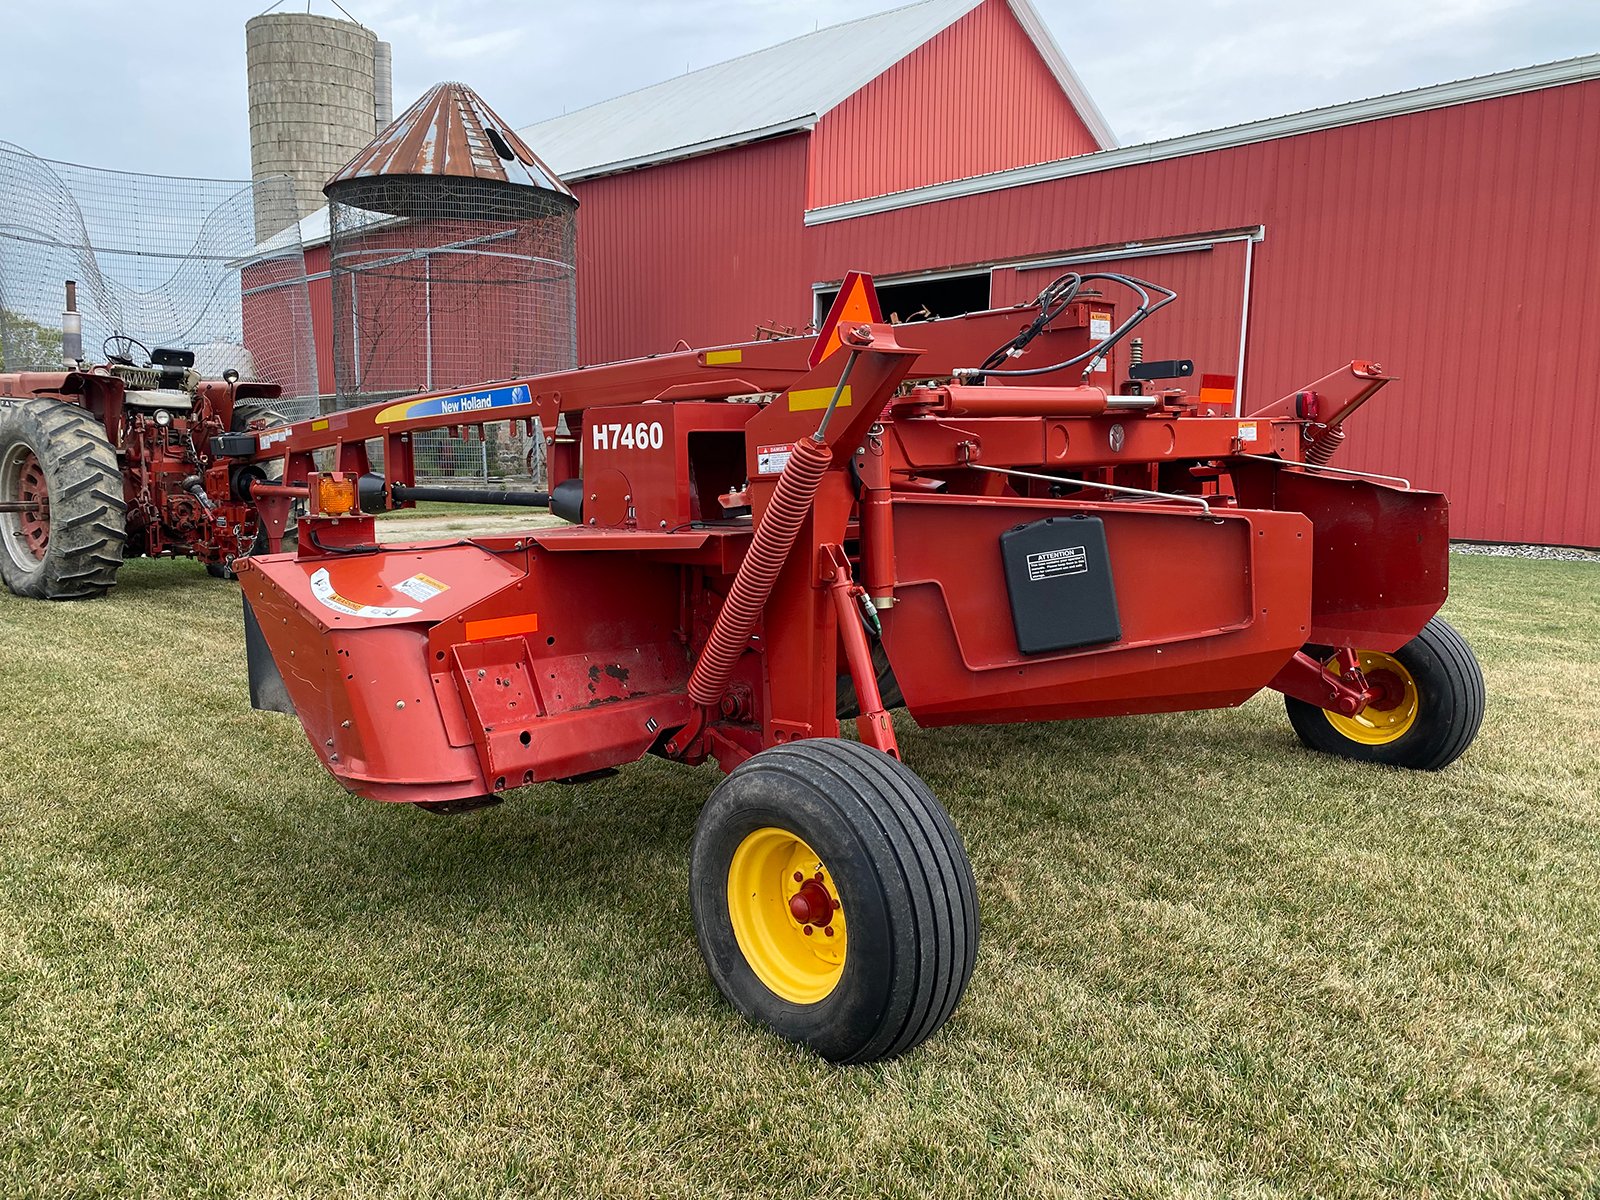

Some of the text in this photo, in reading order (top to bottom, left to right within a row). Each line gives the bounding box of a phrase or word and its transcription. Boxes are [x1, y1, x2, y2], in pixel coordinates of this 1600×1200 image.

[441, 394, 492, 413] New Holland
[592, 422, 664, 449] H7460
[1038, 549, 1075, 560] ATTENTION
